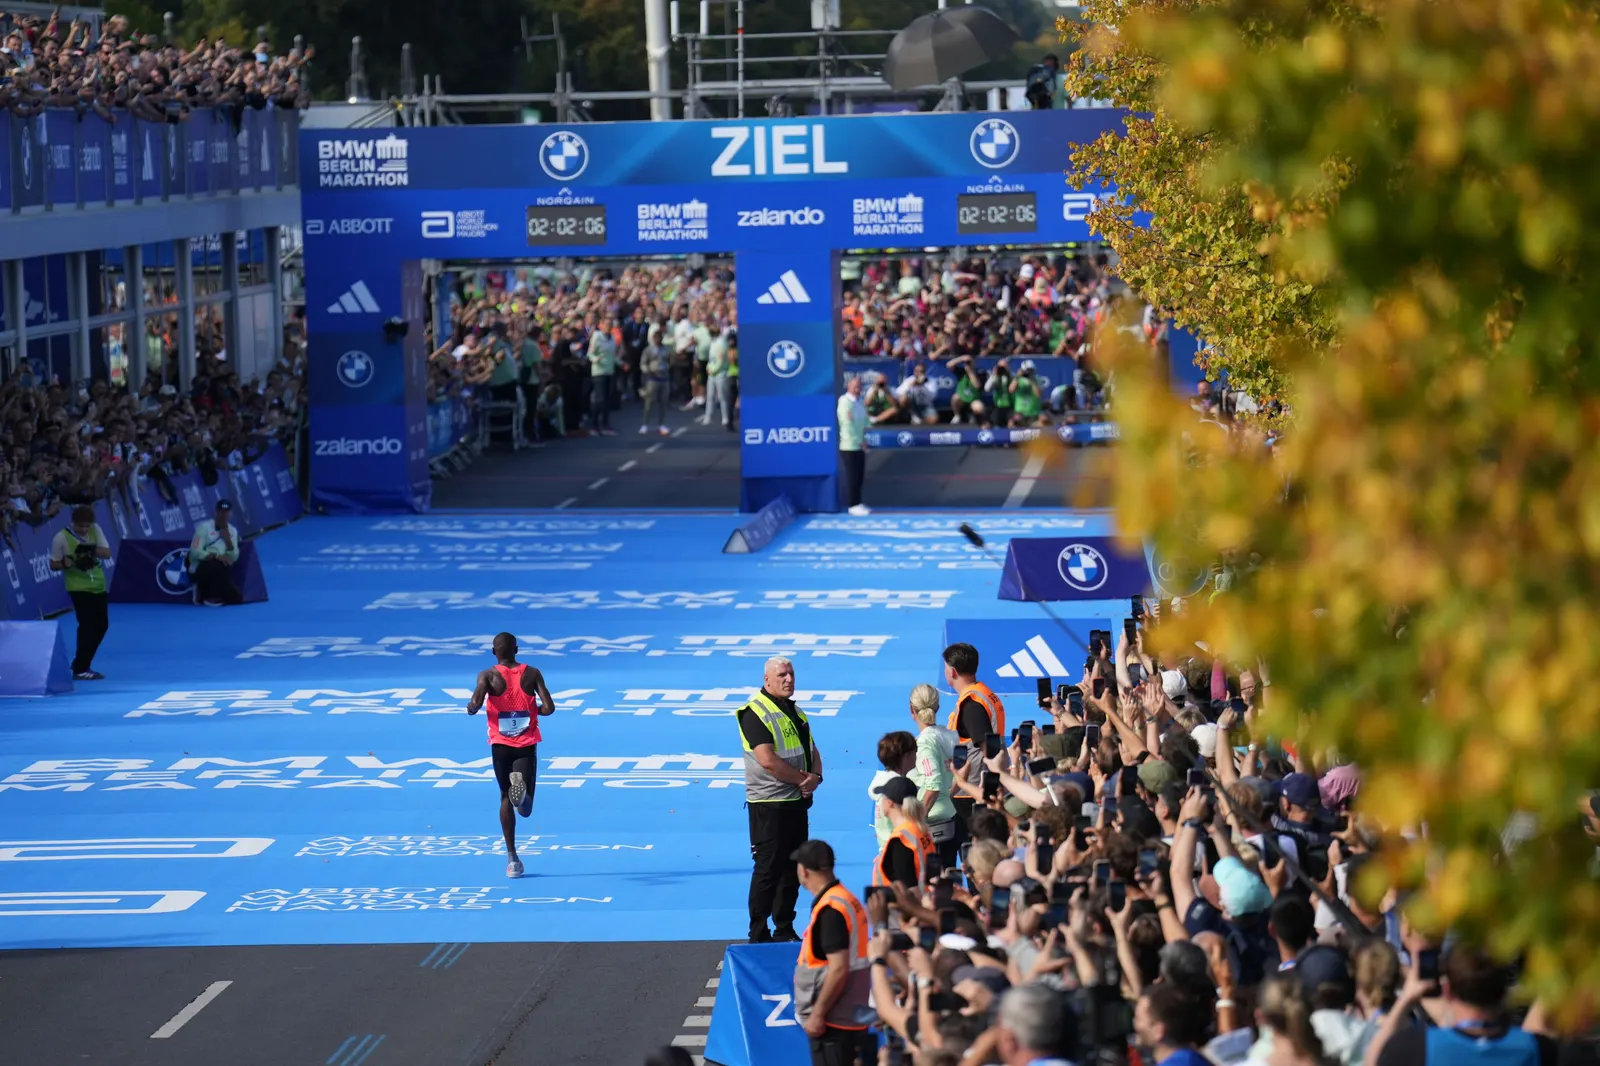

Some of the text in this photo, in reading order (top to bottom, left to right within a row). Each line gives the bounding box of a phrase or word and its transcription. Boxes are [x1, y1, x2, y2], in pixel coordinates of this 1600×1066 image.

[318, 139, 374, 159] BMW
[711, 124, 849, 176] ZIEL
[319, 159, 376, 173] BERLIN
[320, 173, 409, 187] MARATHON
[638, 204, 681, 219] BMW
[853, 198, 897, 214] BMW
[737, 207, 825, 227] zalando
[853, 213, 898, 224] BERLIN
[959, 205, 1036, 224] 02:02:06
[328, 218, 394, 234] ABBOTT
[528, 217, 606, 236] 02:02:06
[638, 218, 682, 230] BERLIN
[853, 223, 924, 236] MARATHON
[638, 229, 708, 241] MARATHON
[766, 426, 832, 444] ABBOTT
[315, 436, 402, 455] zalando
[1062, 546, 1098, 561] BMW
[21, 755, 494, 772] BMW
[0, 769, 494, 783] BERLIN
[240, 892, 486, 900] WORLD
[247, 886, 509, 894] ABBOTT
[224, 903, 492, 912] MAJORS
[231, 896, 612, 907] MARATHON
